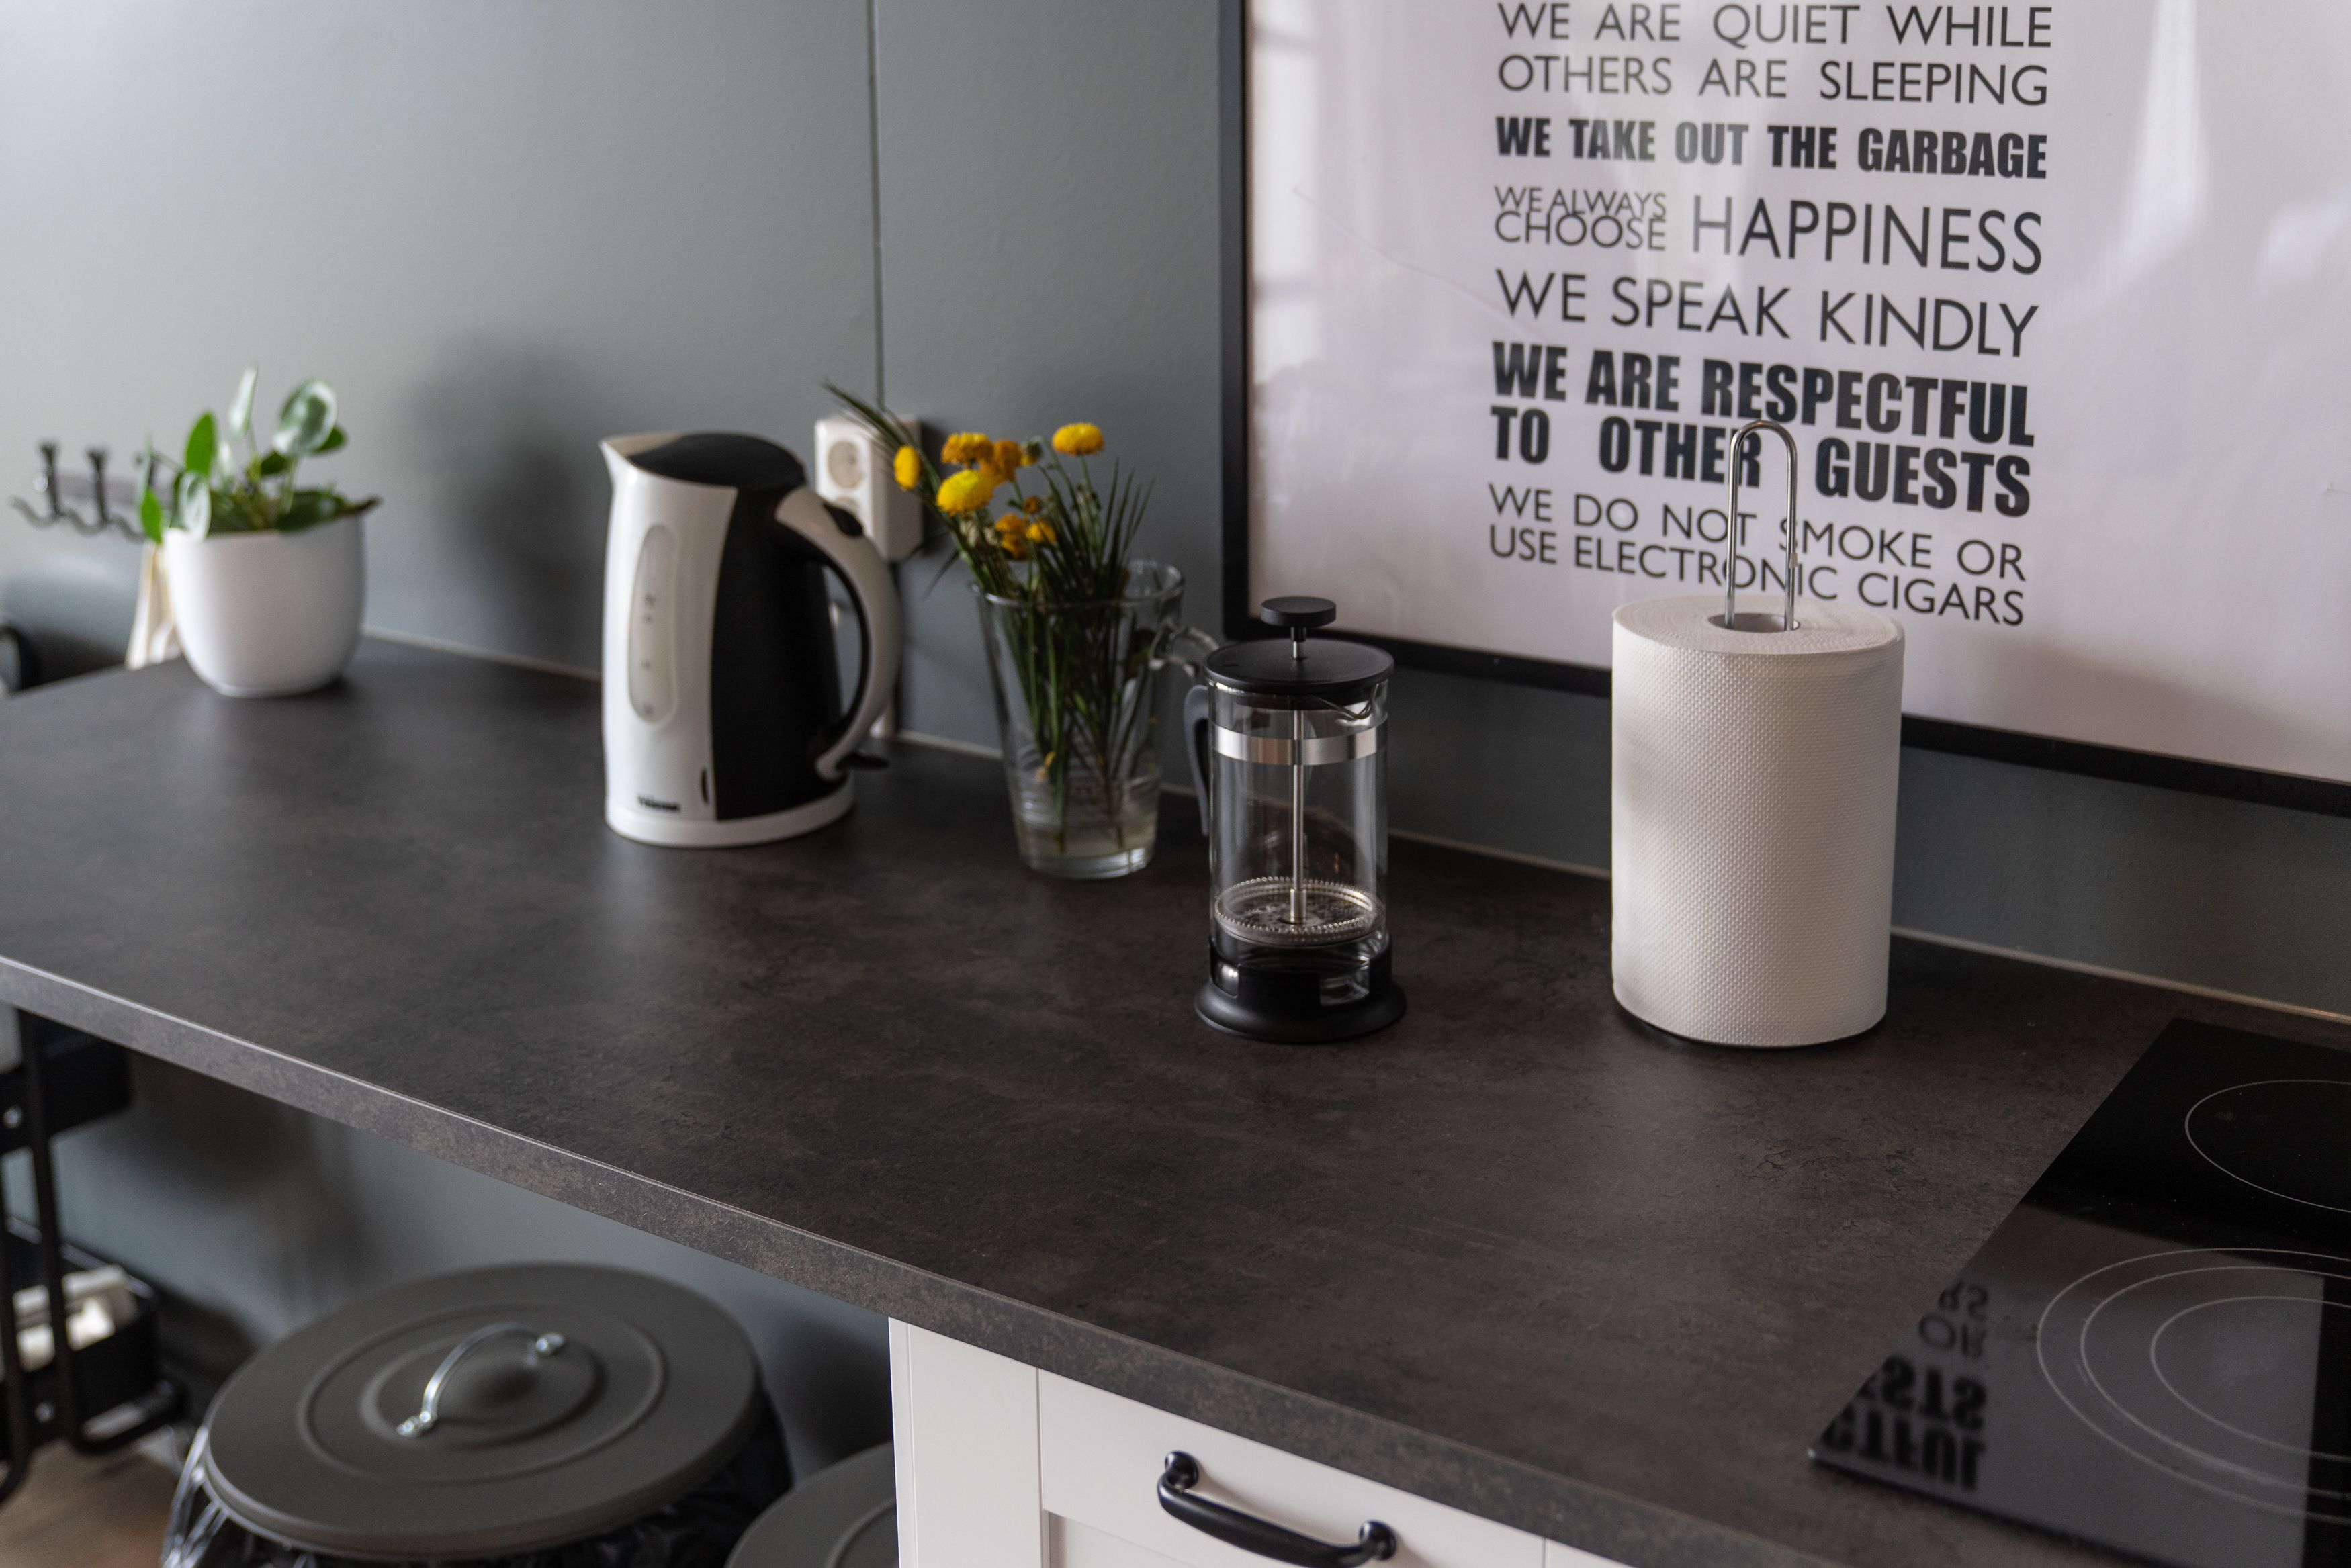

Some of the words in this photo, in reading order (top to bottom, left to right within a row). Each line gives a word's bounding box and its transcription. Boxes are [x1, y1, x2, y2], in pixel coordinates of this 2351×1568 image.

[1498, 3, 1569, 39] WE
[1595, 4, 1679, 41] ARE
[1714, 5, 1860, 49] QUIET
[1886, 5, 2052, 48] WHILE
[1499, 55, 1671, 94] OTHERS
[1699, 59, 1786, 98] ARE
[1820, 60, 2047, 106] SLEEPING
[1496, 116, 1550, 157] WE
[1568, 118, 1654, 160] TAKE
[1676, 122, 1748, 164] OUT
[1767, 125, 1837, 169] THE
[1858, 128, 2047, 179] GARBAGE
[1495, 187, 1542, 212] WE
[1551, 188, 1667, 218] ALWAYS
[1495, 212, 1667, 251] CHOOSE
[1694, 196, 2041, 275] HAPPINESS
[1496, 269, 1585, 322] WE
[1611, 276, 1789, 338] SPEAK
[1820, 291, 2039, 357] KINDLY
[1492, 341, 1567, 402] WE
[1585, 349, 1680, 412] ARE
[1701, 359, 2034, 447] RESPECTFUL
[1491, 406, 1550, 465] TO
[1599, 416, 1761, 488] OTHER
[1815, 437, 2030, 518] GUESTS
[1489, 484, 1551, 522] WE
[1574, 494, 1638, 532] DO
[1662, 504, 1757, 547] NOT
[1957, 540, 2025, 582] OR
[1490, 524, 1556, 564] USE
[1575, 535, 1837, 600] ELECTRONIC
[1858, 573, 2023, 627] CIGARS
